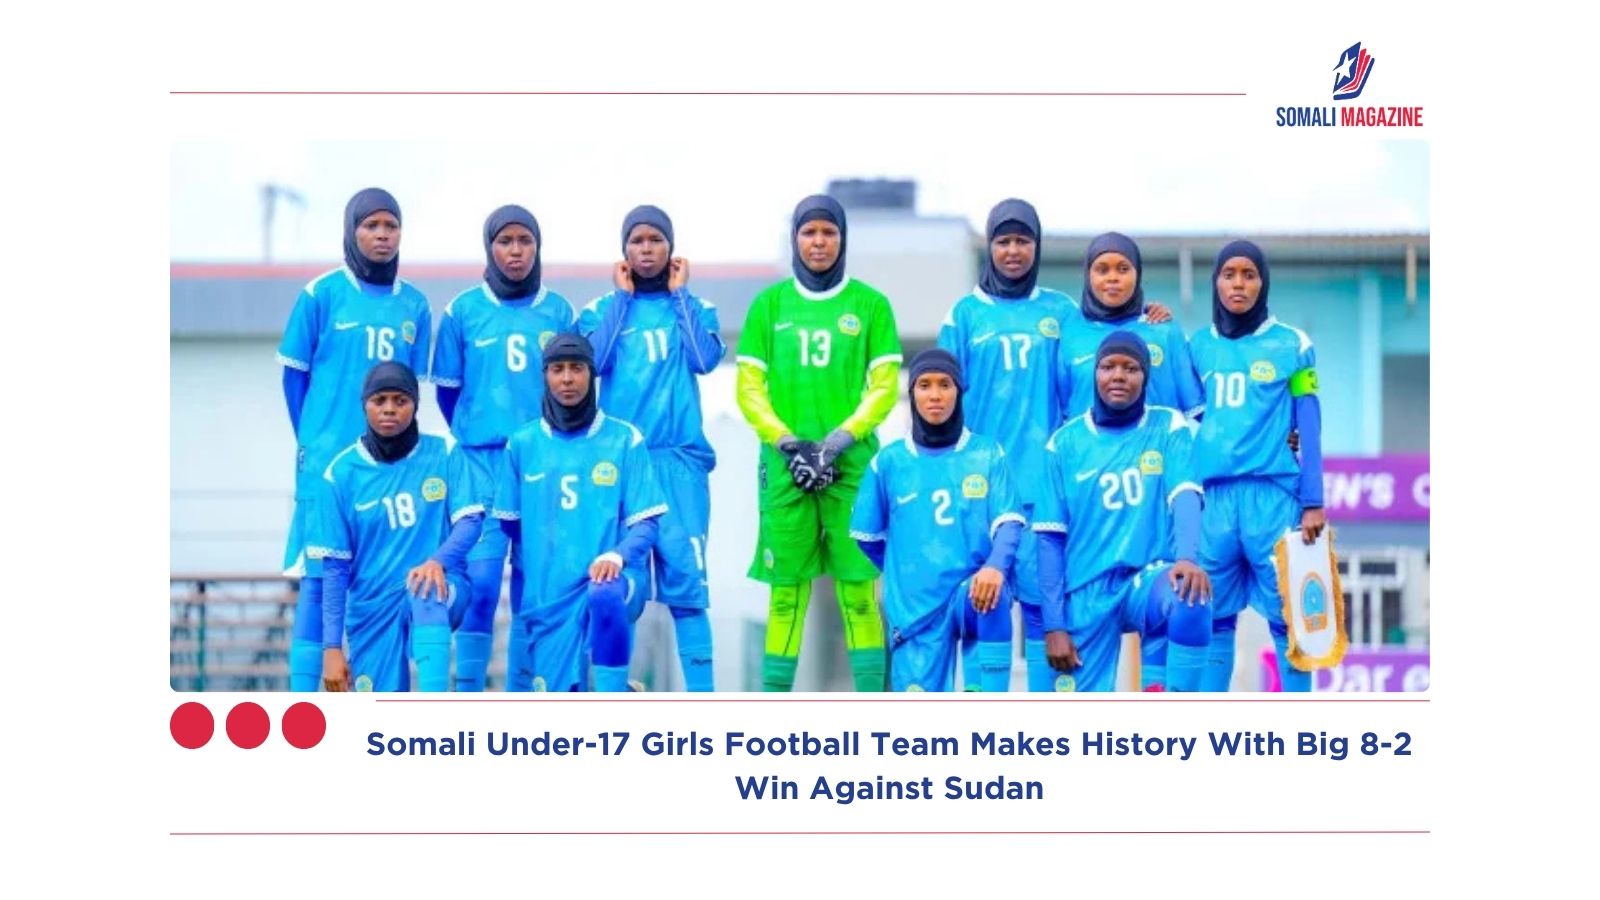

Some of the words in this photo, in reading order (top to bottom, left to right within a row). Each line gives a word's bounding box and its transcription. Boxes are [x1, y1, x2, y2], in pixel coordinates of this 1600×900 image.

[366, 325, 395, 361] 16
[506, 333, 527, 372] 6
[643, 328, 668, 364] 11
[798, 328, 832, 367] 13
[1000, 332, 1032, 371] 17
[1214, 371, 1246, 409] 10
[560, 474, 579, 511] 5
[931, 488, 955, 527] 2
[1099, 466, 1145, 511] 20
[382, 492, 416, 530] 18
